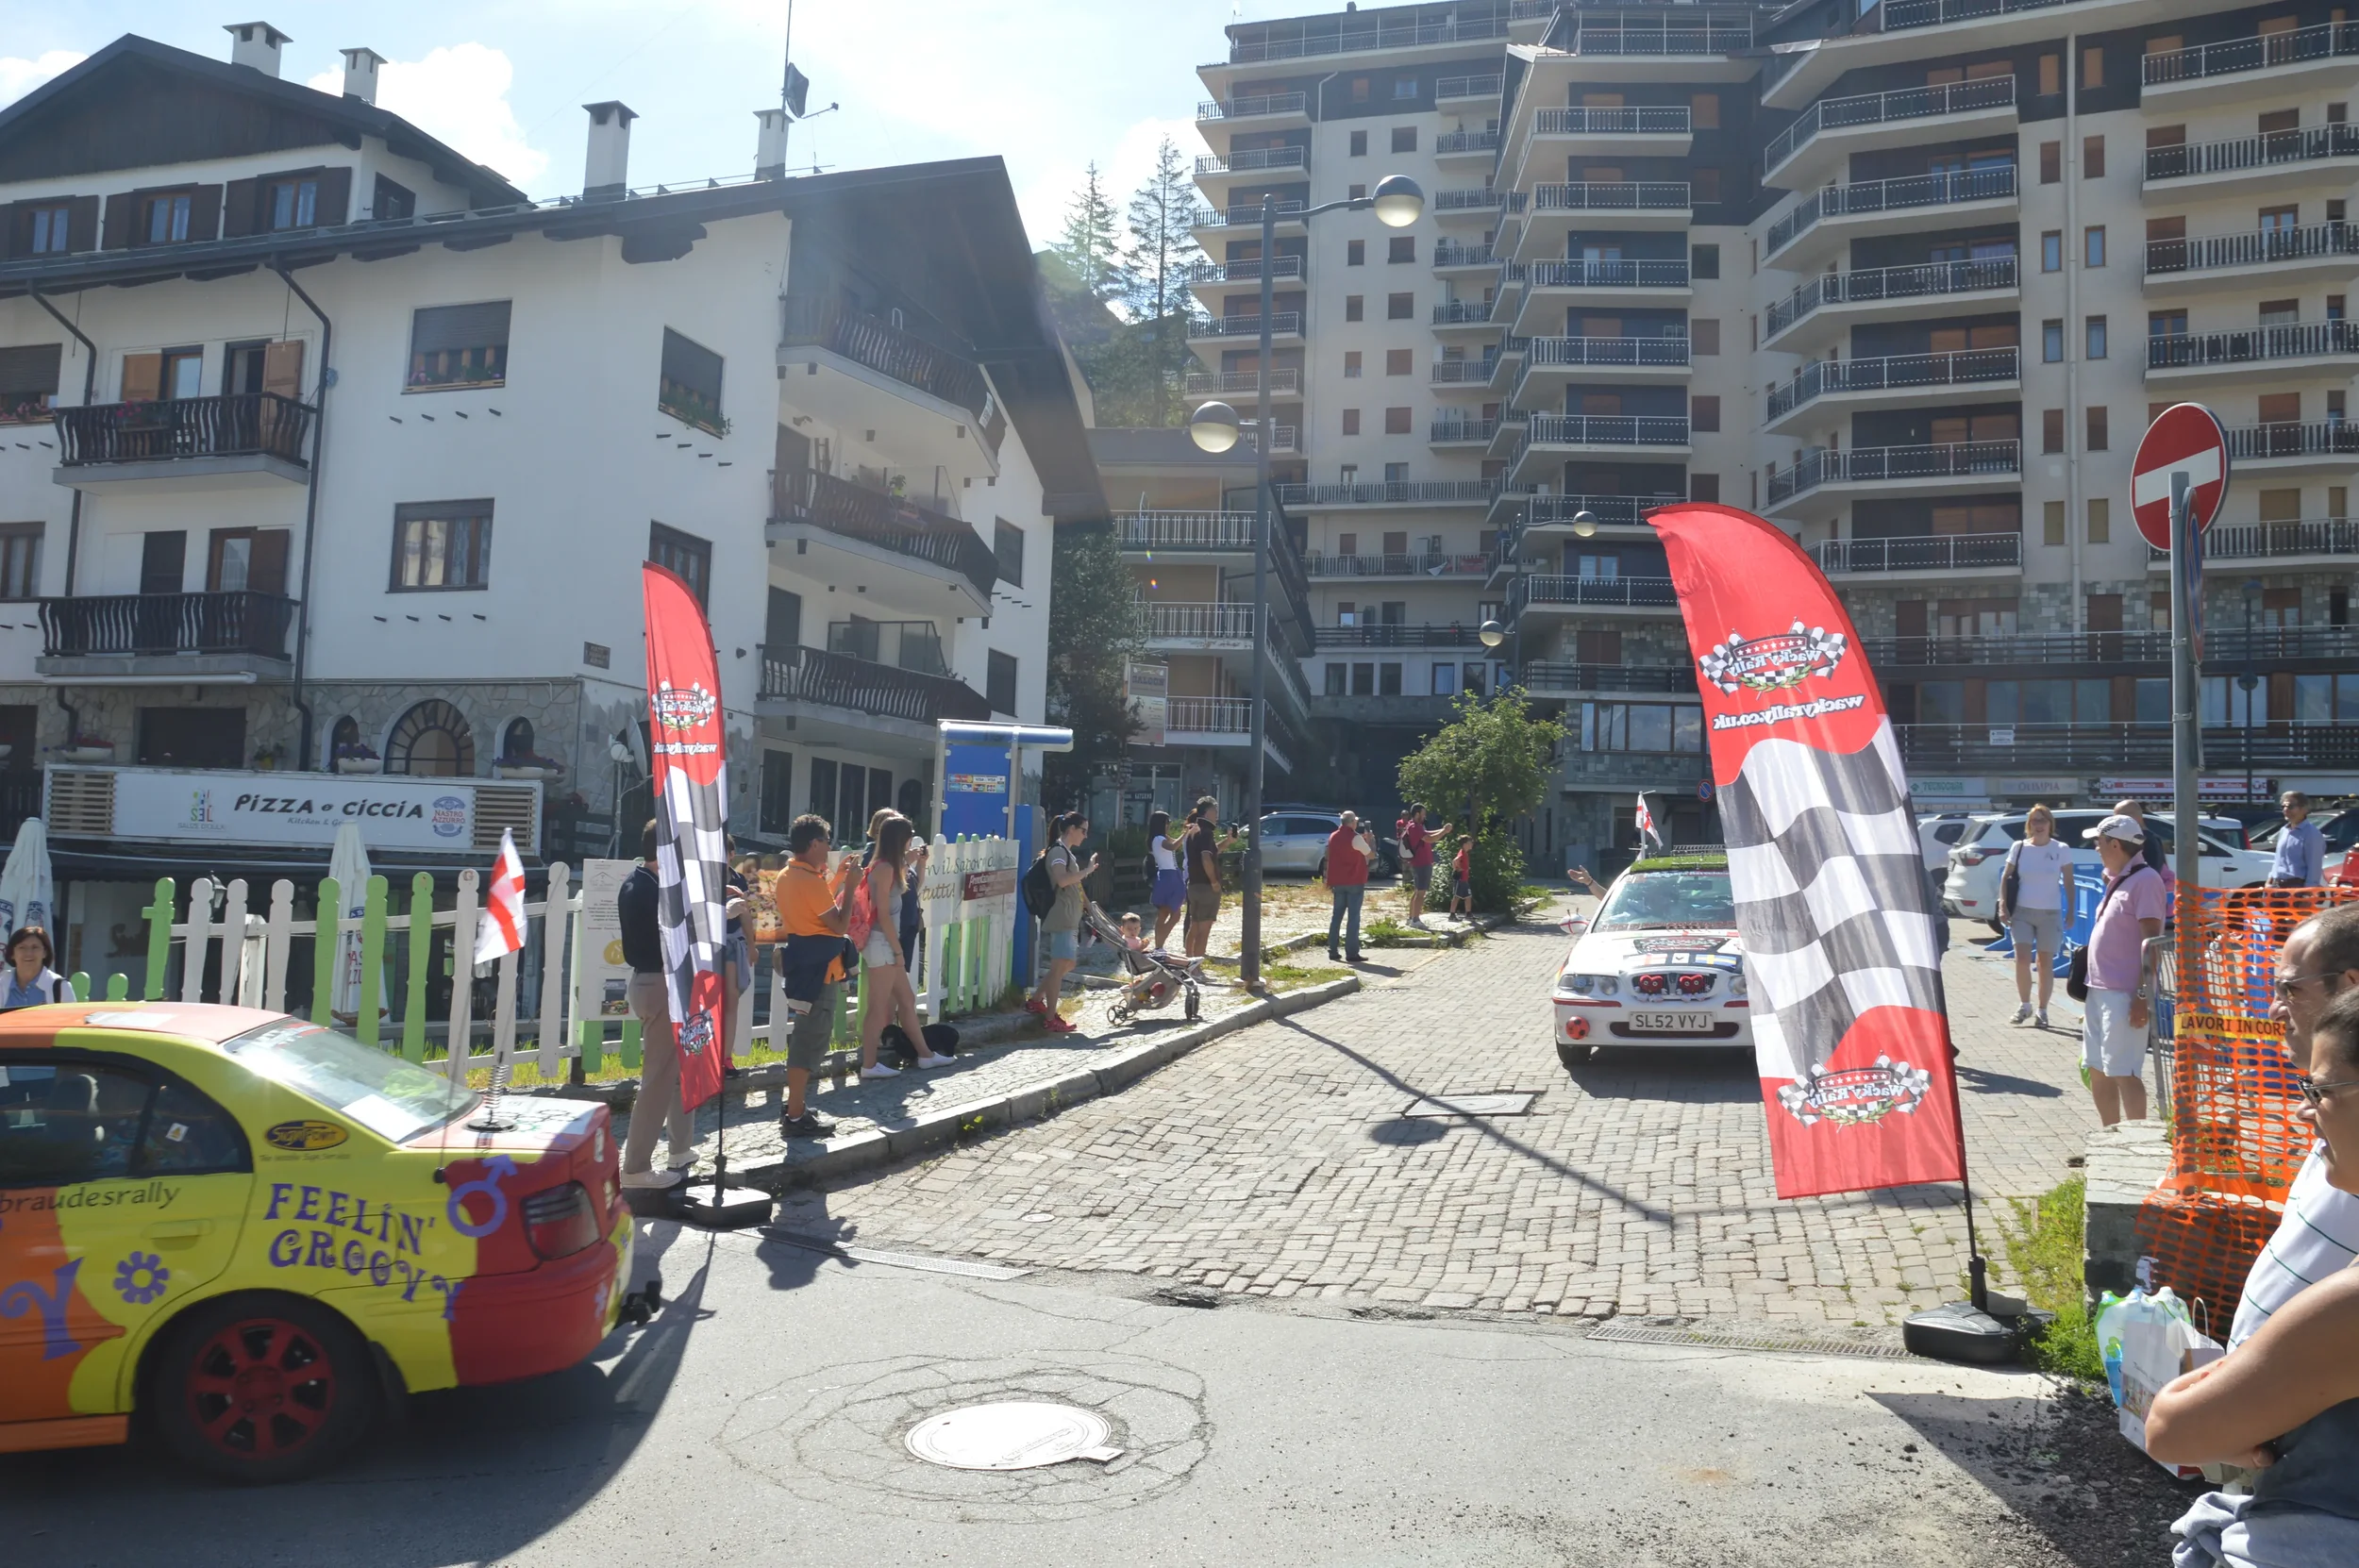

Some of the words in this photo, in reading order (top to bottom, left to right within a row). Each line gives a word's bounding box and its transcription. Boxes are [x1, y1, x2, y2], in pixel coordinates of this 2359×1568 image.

[2017, 781, 2060, 792] OLIMPIA
[434, 809, 463, 818] NASTRO
[287, 817, 320, 826] Kitchen
[431, 815, 466, 825] AZZURRO
[1635, 1014, 1674, 1029] SL52
[1678, 1015, 1708, 1029] VYJ
[2181, 1015, 2233, 1032] LAVORI
[2236, 1019, 2252, 1033] IN
[2255, 1020, 2285, 1036] CORS
[268, 1228, 466, 1323] GROOVY
